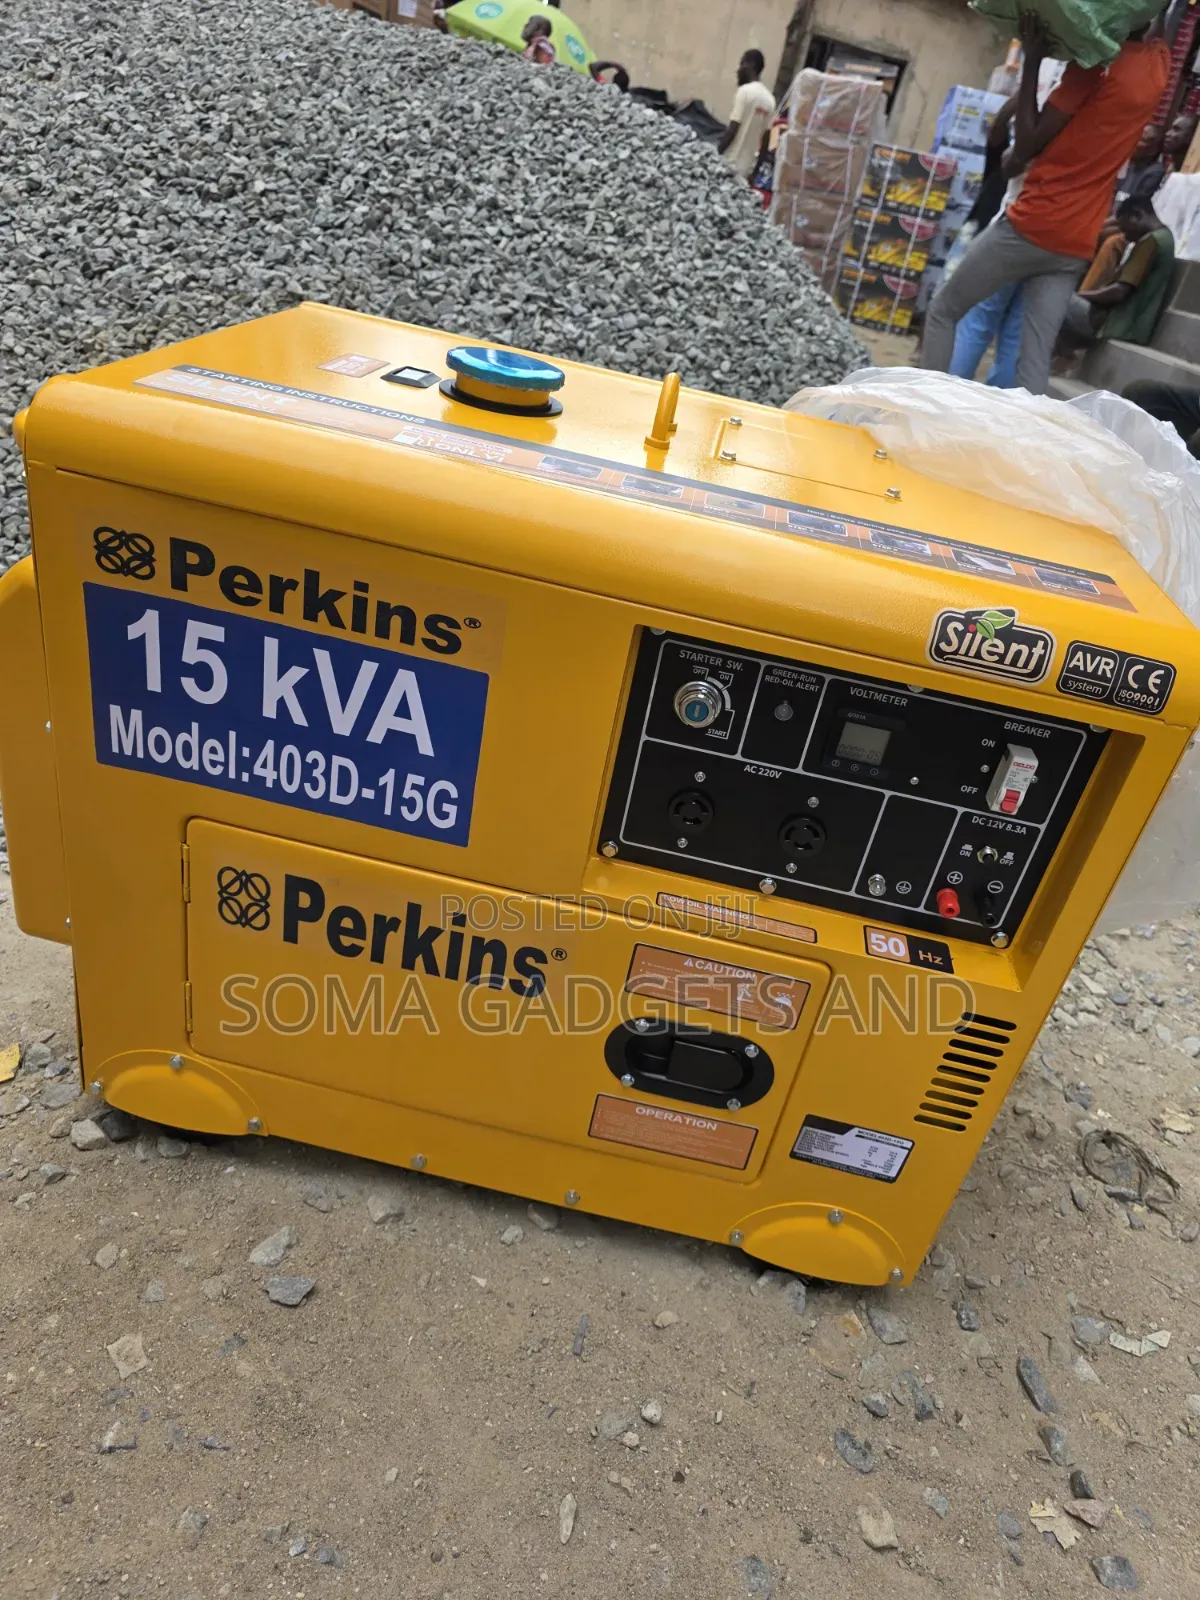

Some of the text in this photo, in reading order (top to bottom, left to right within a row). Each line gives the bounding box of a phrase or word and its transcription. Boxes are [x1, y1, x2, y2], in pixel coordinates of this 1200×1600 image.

[165, 373, 298, 406] SILENT
[188, 367, 284, 391] STARTING
[286, 388, 426, 424] INSTRUCTIONS
[435, 443, 504, 463] ONLY!
[939, 621, 1045, 671] Silent
[678, 649, 744, 672] STARTER SW.
[692, 667, 730, 681] OFF ON
[772, 668, 817, 683] GREEN-RUN
[1068, 650, 1165, 695] AVR CE
[126, 608, 435, 758] 15 kVA
[764, 674, 820, 693] RED-OIL ALERT
[1066, 679, 1103, 695] system
[849, 686, 909, 707] VOLTMETER
[1118, 688, 1160, 706] ISO9001
[707, 728, 727, 737] START
[1003, 720, 1051, 739] BREAKER
[981, 738, 996, 748] ON
[108, 703, 459, 830] Model:403D-15G
[743, 764, 782, 779] AC 220V
[960, 784, 979, 795] OFF
[971, 815, 1027, 835] DC 12V 8.3A
[959, 850, 972, 858] ON
[999, 857, 1014, 866] OFF
[686, 901, 702, 909] OIL
[869, 931, 943, 965] 50 Hz
[695, 959, 757, 981] CAUTION
[635, 1105, 718, 1132] OPERATION
